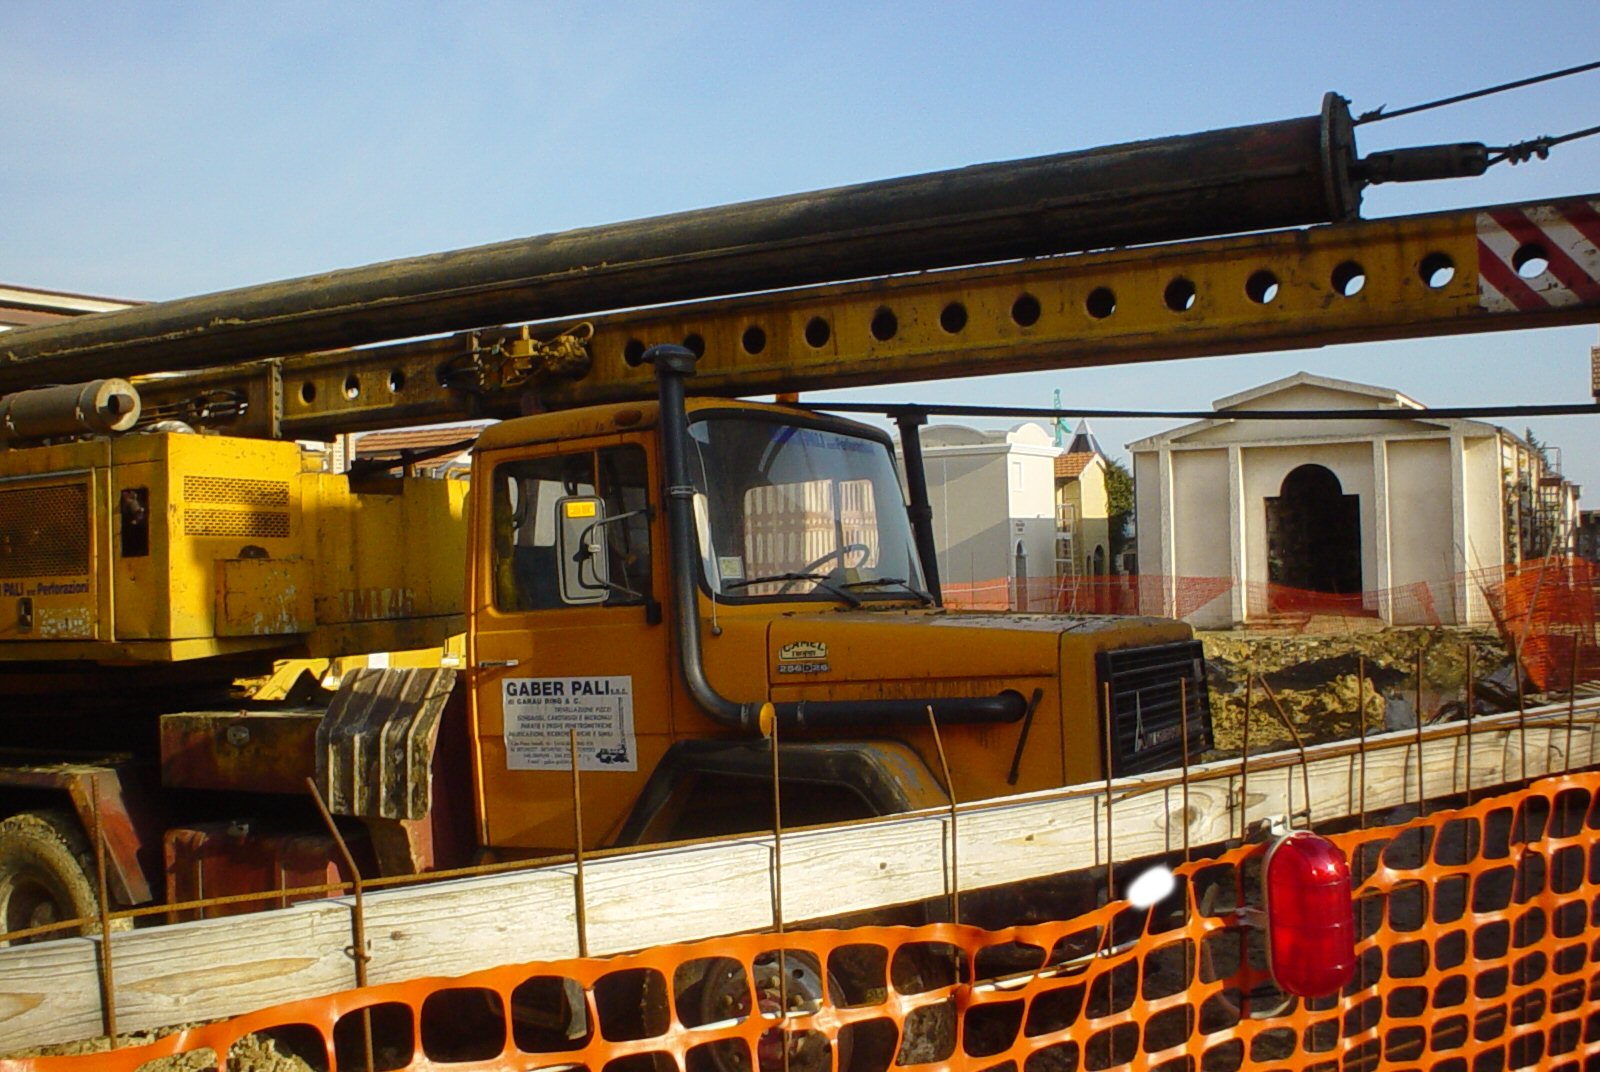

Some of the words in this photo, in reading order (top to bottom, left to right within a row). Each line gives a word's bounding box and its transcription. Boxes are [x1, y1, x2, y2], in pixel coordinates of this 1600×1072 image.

[37, 580, 89, 595] Perforazioni
[506, 681, 564, 696] GABER
[571, 680, 610, 696] PALI
